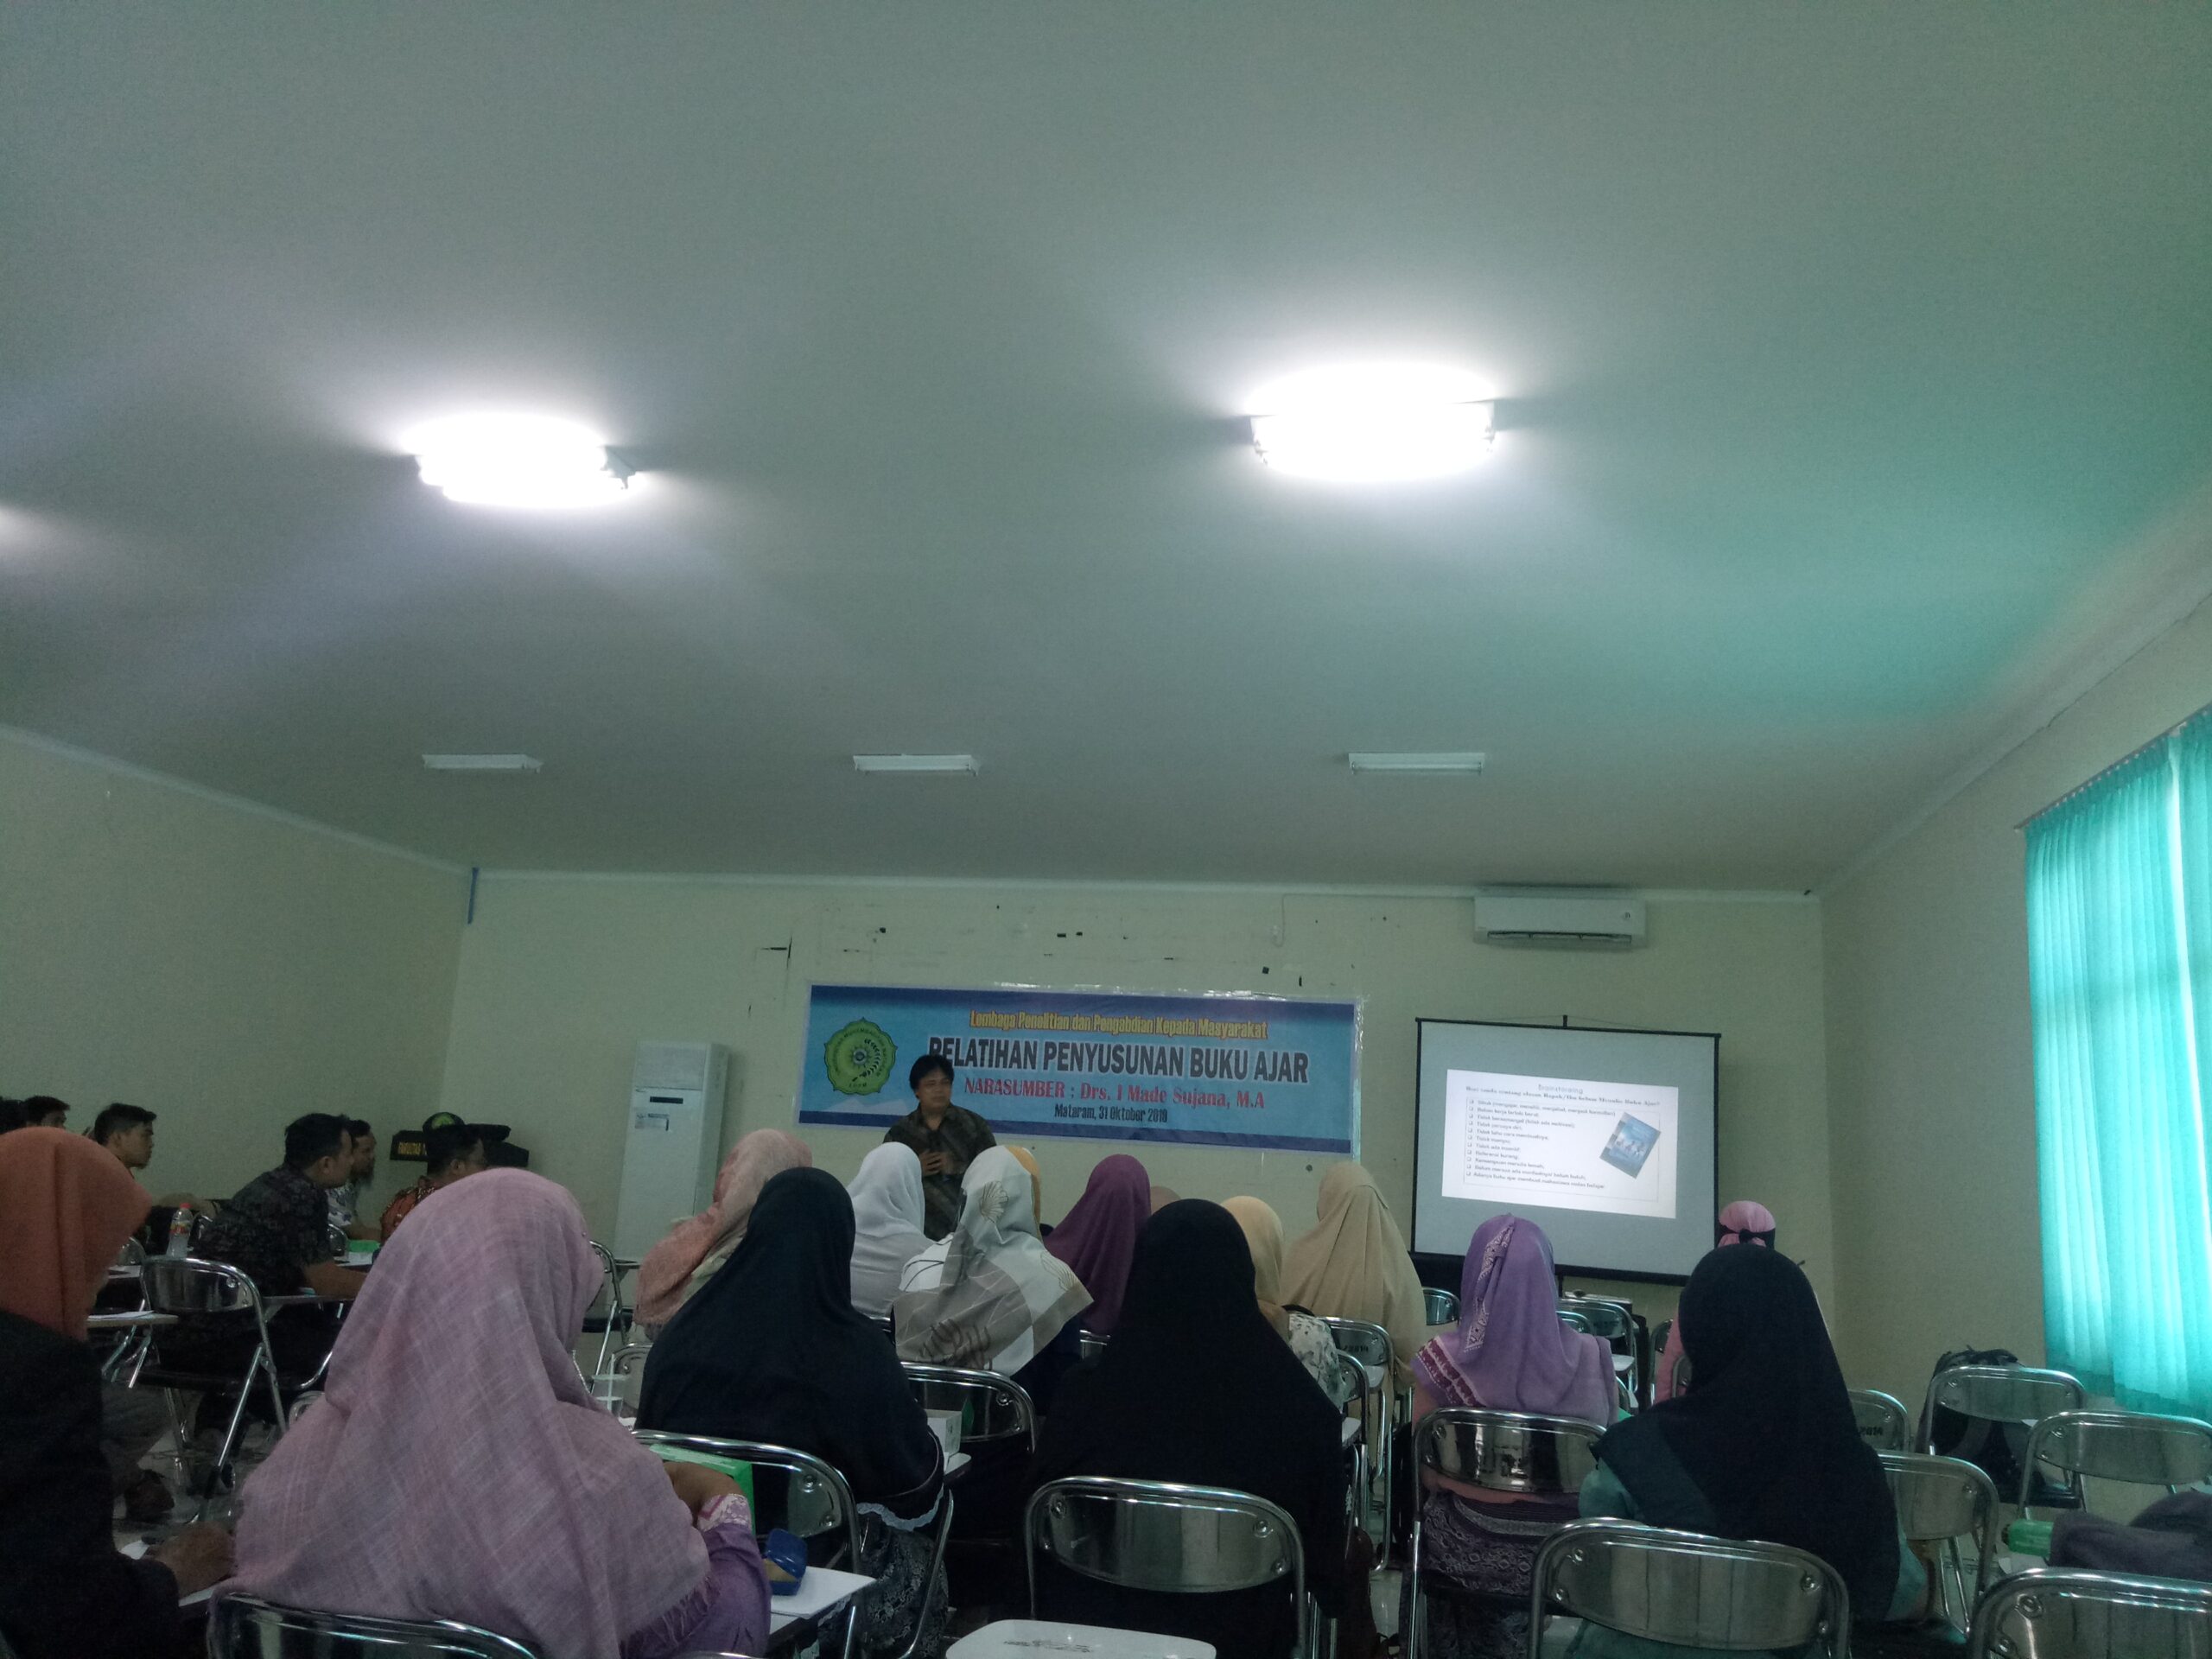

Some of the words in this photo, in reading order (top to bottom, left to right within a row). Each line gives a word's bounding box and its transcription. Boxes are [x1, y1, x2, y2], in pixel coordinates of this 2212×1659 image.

[1018, 1011, 1070, 1031] Penelitian
[1071, 1013, 1092, 1032] dan
[1093, 1013, 1154, 1035] Pengabdian
[1155, 1016, 1195, 1037] Kepada
[1198, 1018, 1268, 1039] Masyarakat
[928, 1036, 1038, 1071] PELATIHAN
[1043, 1040, 1184, 1077] PENYUSUNAN
[1189, 1046, 1249, 1080] BUKU
[1253, 1050, 1309, 1084] AJAR
[964, 1077, 1065, 1098] NARASUMBER
[1080, 1082, 1111, 1101] Drs.
[1128, 1084, 1166, 1103] Made
[1173, 1087, 1230, 1109] Sujana,
[1236, 1090, 1265, 1109] M.A
[1054, 1103, 1096, 1120] Mataram,
[1098, 1106, 1108, 1120] 31
[1109, 1106, 1146, 1122] Oktober
